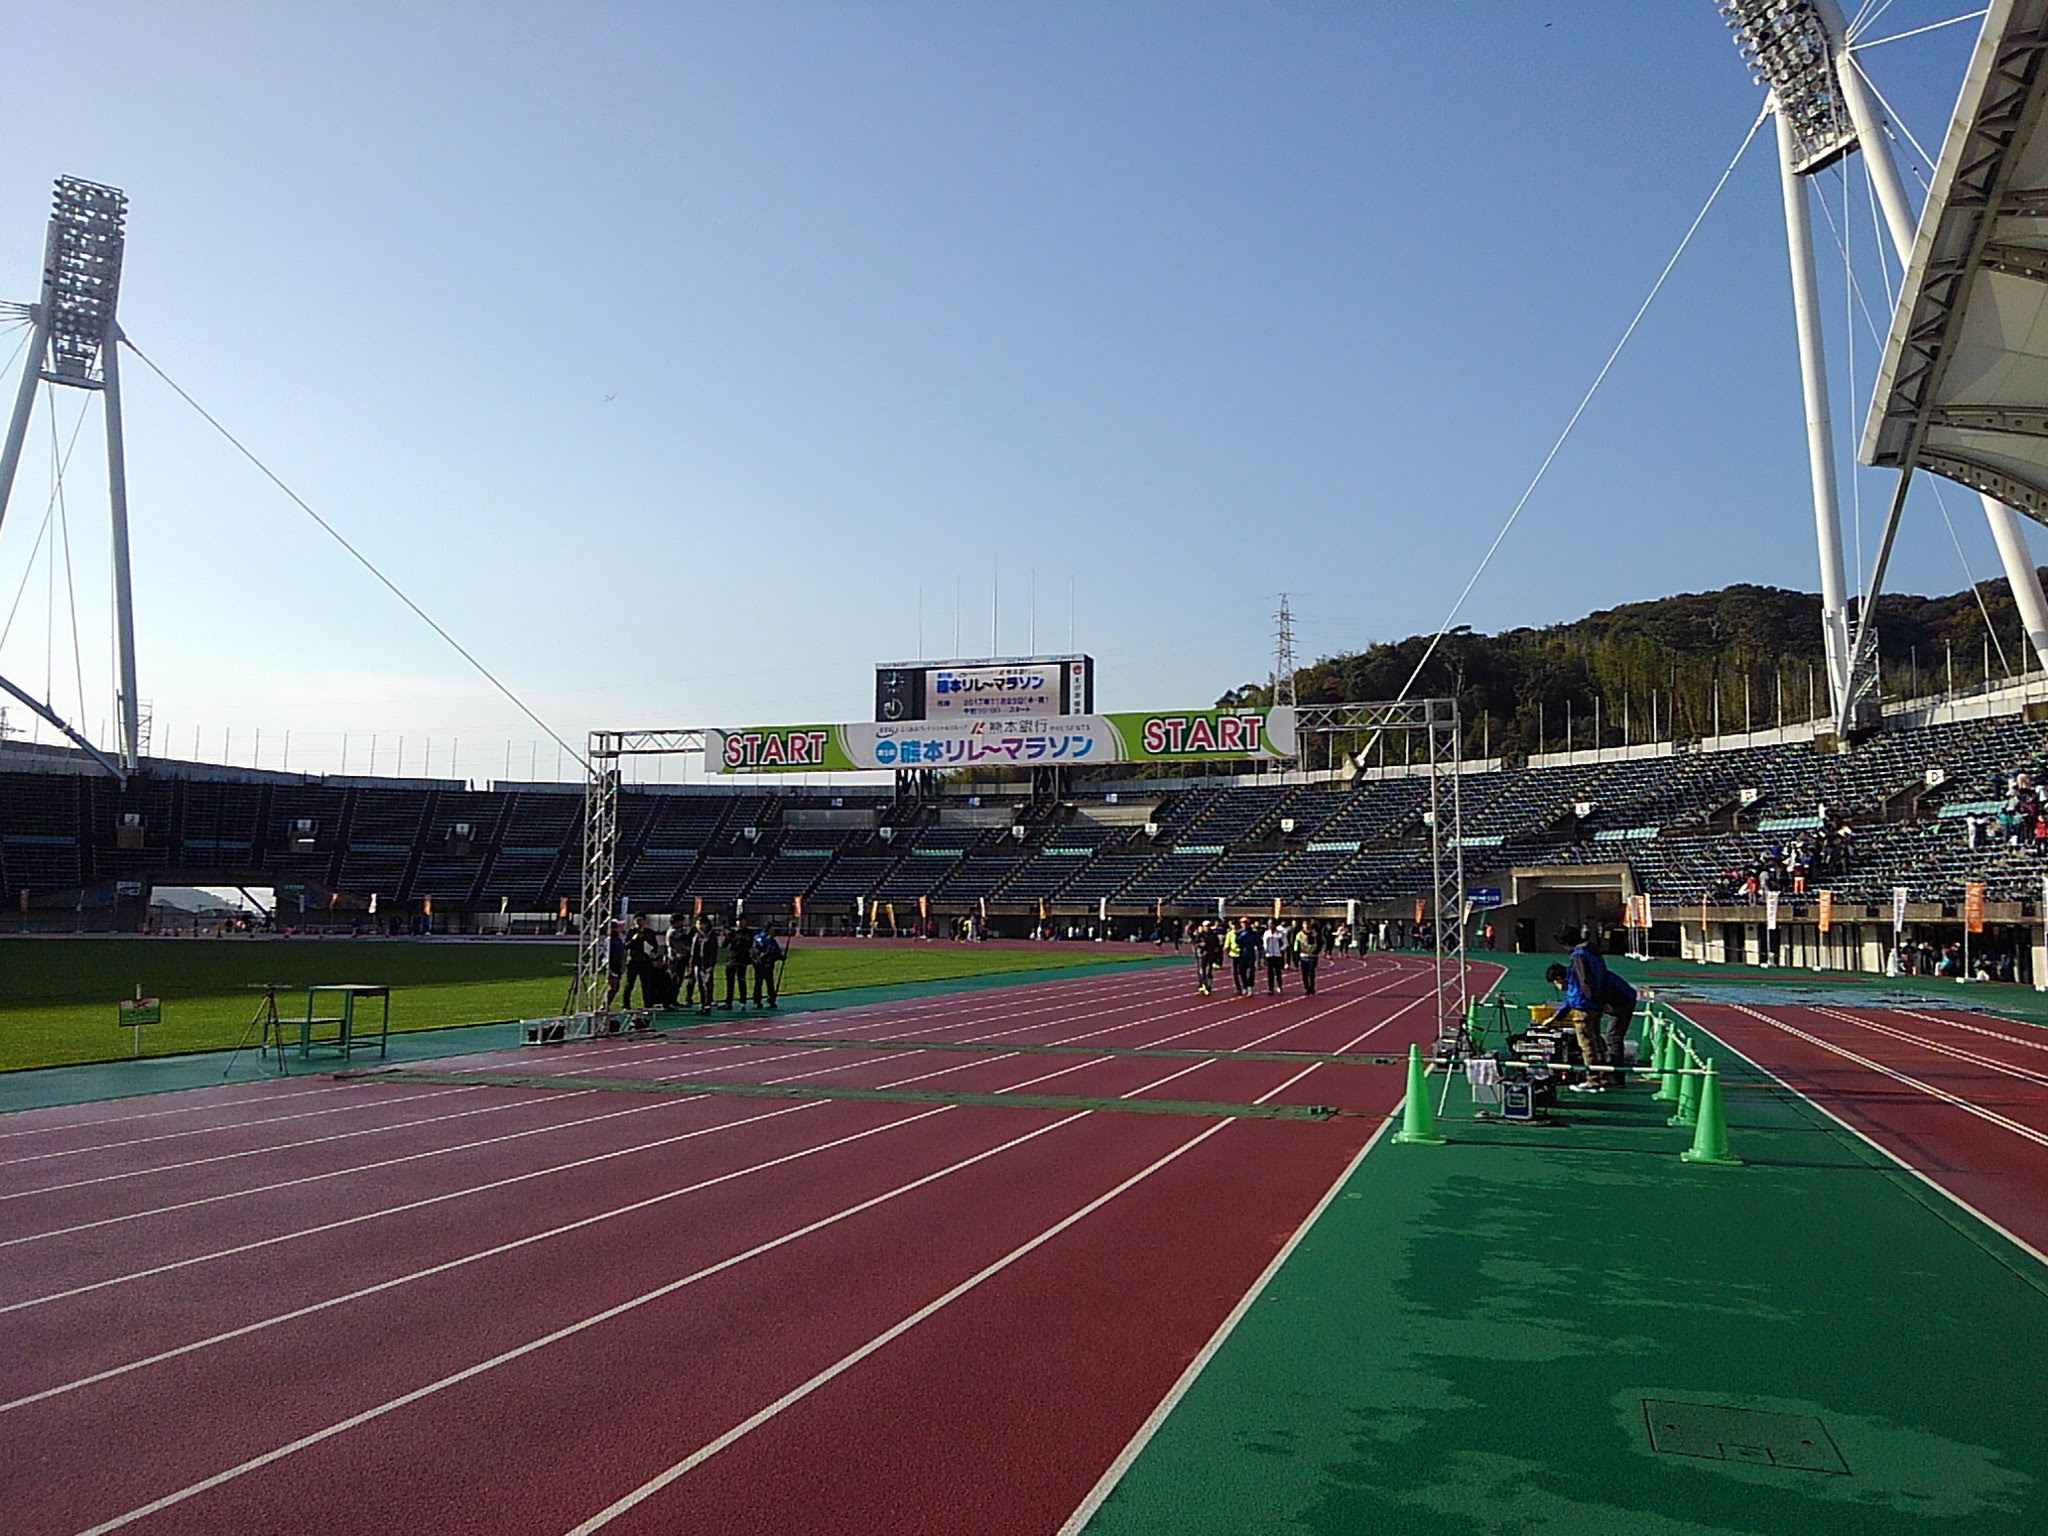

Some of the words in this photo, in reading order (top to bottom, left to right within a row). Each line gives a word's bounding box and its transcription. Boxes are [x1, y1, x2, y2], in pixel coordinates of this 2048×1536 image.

[988, 719, 1048, 734] 熊本銀行
[1144, 716, 1263, 753] START
[725, 732, 826, 766] START
